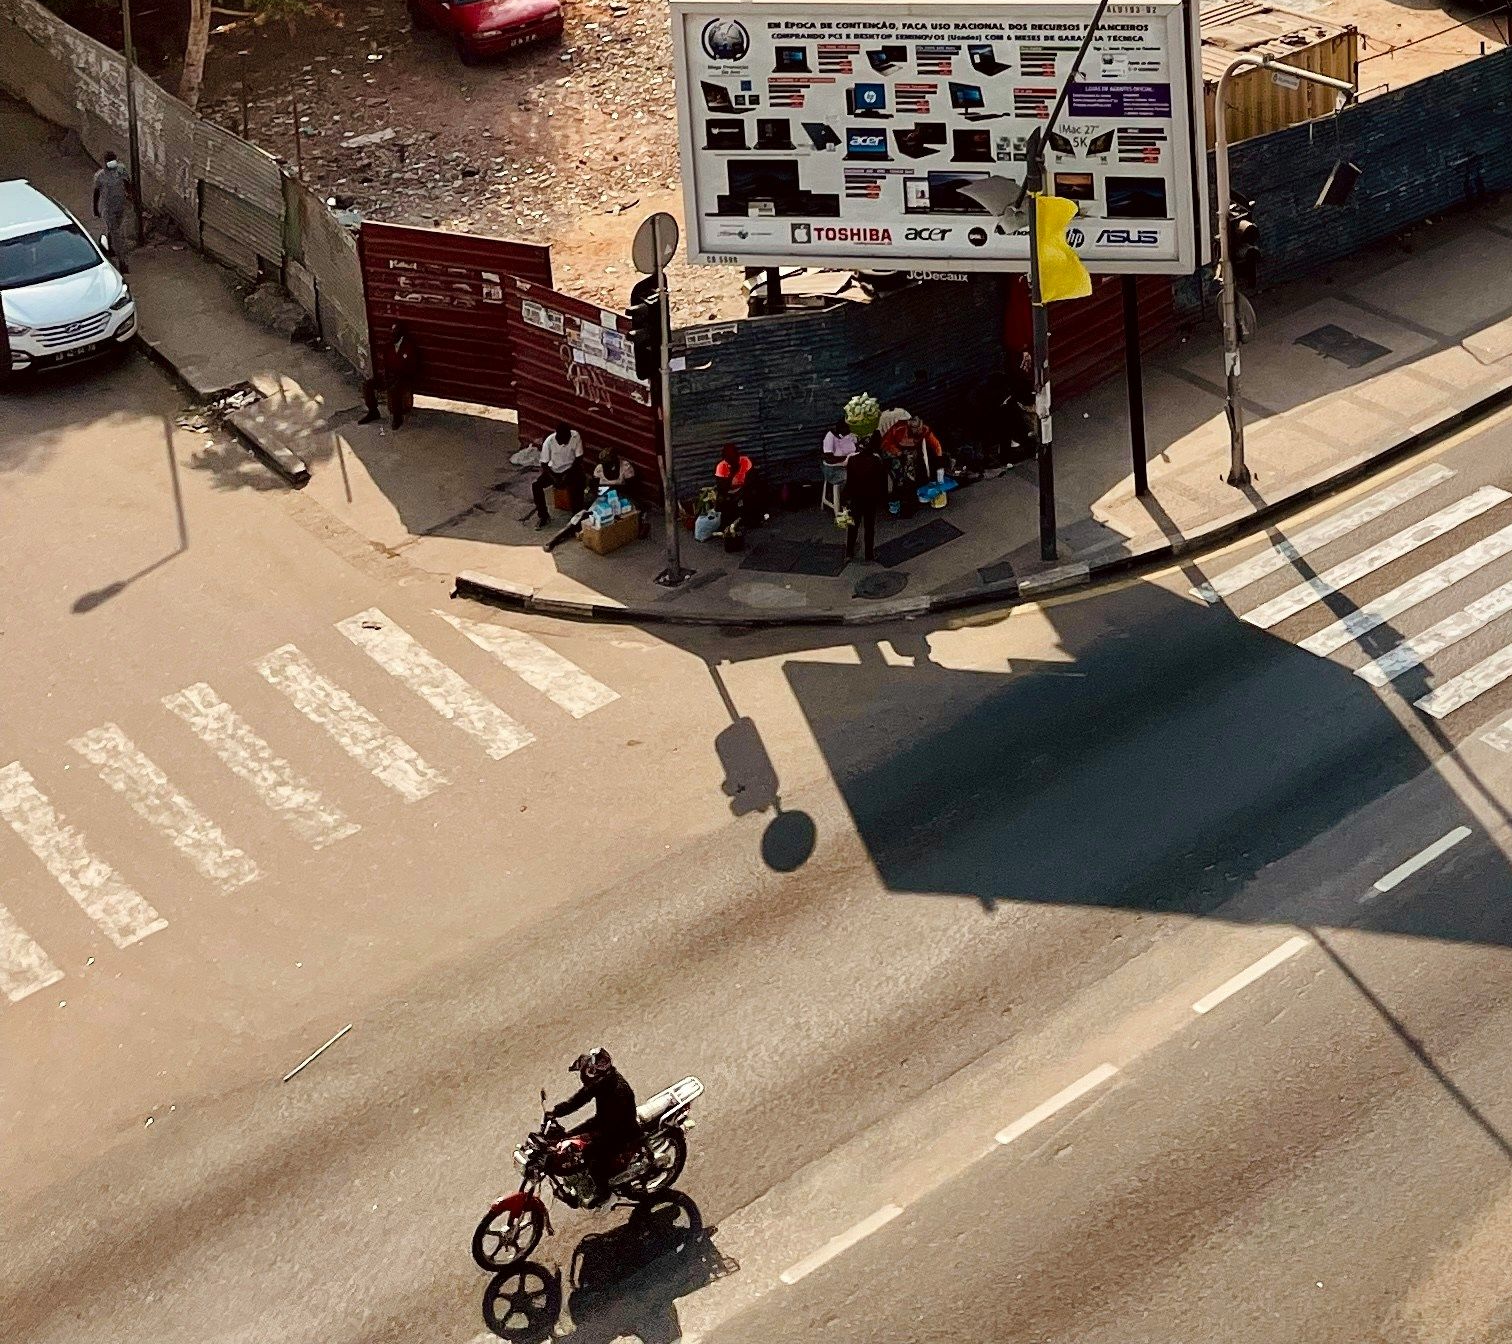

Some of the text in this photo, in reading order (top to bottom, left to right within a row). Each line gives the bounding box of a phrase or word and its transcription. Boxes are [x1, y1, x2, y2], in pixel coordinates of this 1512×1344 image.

[931, 22, 950, 30] USO
[1031, 23, 1080, 31] RECURSOS
[1107, 34, 1144, 42] TÉCNICA
[850, 135, 884, 146] acer
[1073, 137, 1088, 148] 5K
[814, 227, 892, 242] TOSHIBA
[904, 227, 952, 241] acer
[1067, 228, 1084, 247] hp
[1095, 229, 1159, 244] ASUS
[906, 269, 968, 282] JCDecaux
